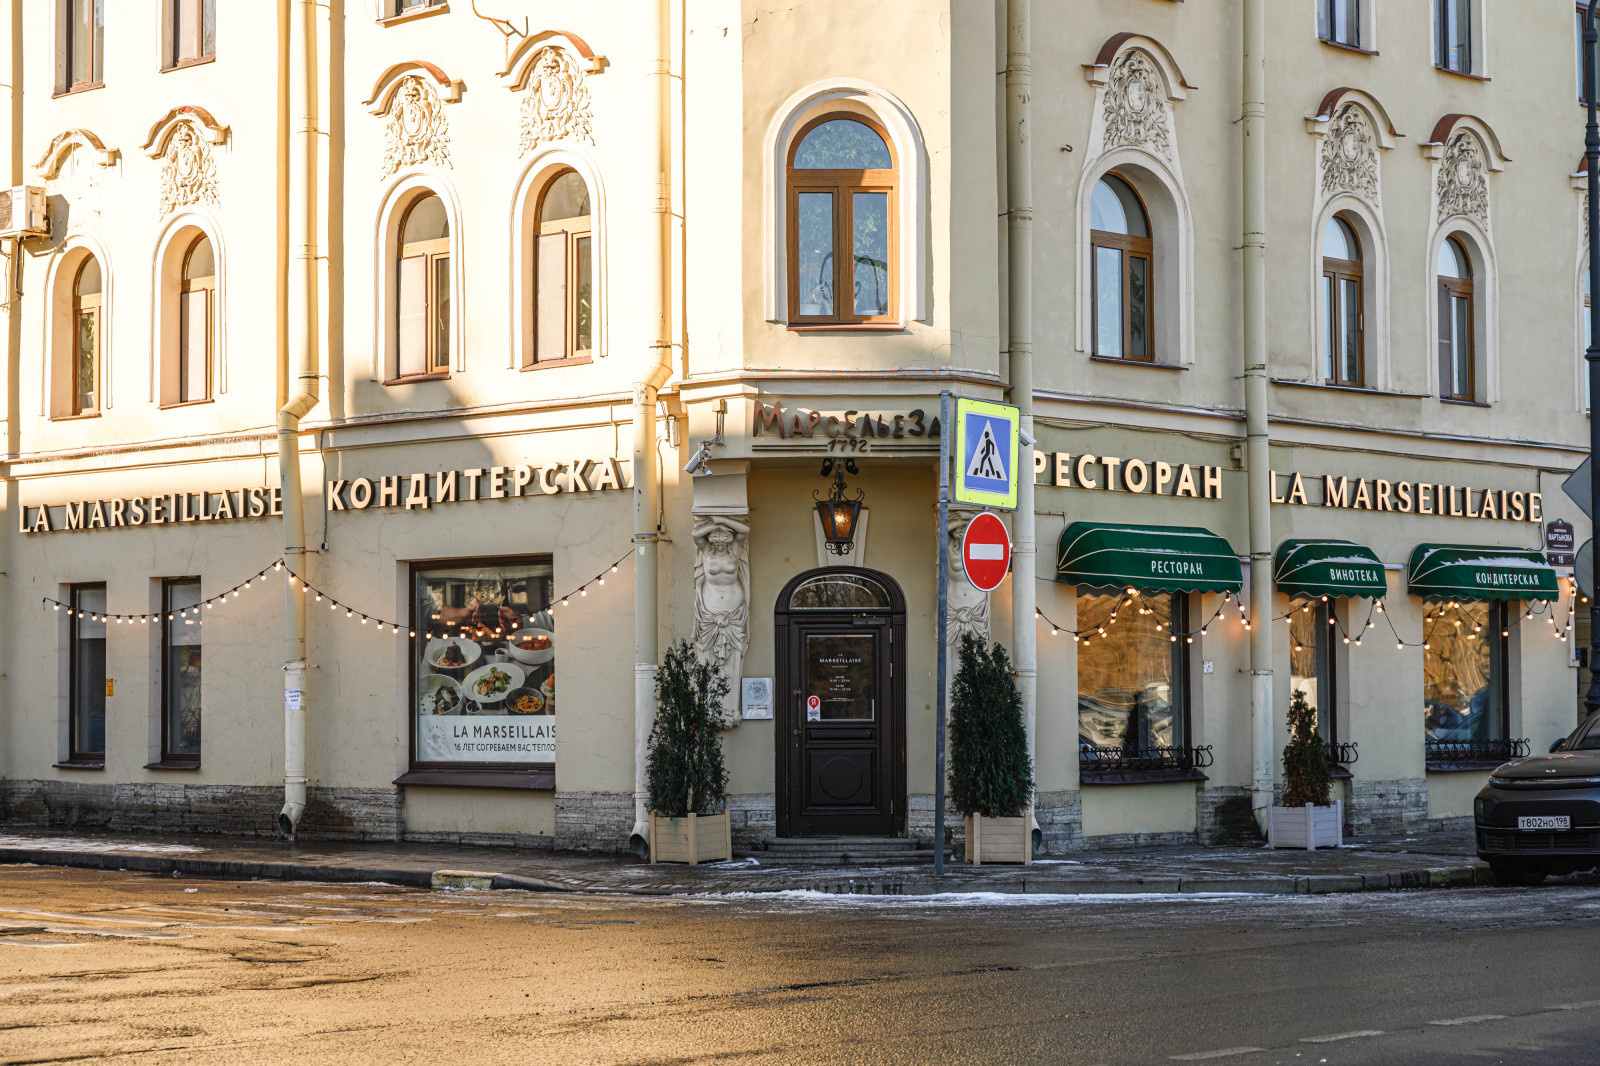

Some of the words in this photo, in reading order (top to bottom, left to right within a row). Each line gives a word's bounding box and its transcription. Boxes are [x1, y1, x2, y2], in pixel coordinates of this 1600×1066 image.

[827, 439, 868, 453] 1792
[1033, 449, 1222, 499] РЕСТОРАН
[327, 457, 634, 511] КОНДИТЕРСКА
[1269, 470, 1307, 505] LA
[1325, 474, 1542, 523] MARSEILLAISE
[19, 505, 52, 533] LA
[65, 486, 283, 530] MARSEILLAISE
[1151, 560, 1203, 575] РЕСТОРАН
[1330, 568, 1379, 582] ВИНОТЕКА
[1475, 571, 1540, 586] КОНДИТЕРСКАЯ
[453, 725, 469, 738] LA
[473, 725, 555, 738] MARSEILLAIS
[462, 743, 475, 752] ЛЕТ
[476, 743, 516, 752] СОГРЕВАЕМ
[517, 743, 531, 752] ВАС
[1555, 817, 1568, 825] 198
